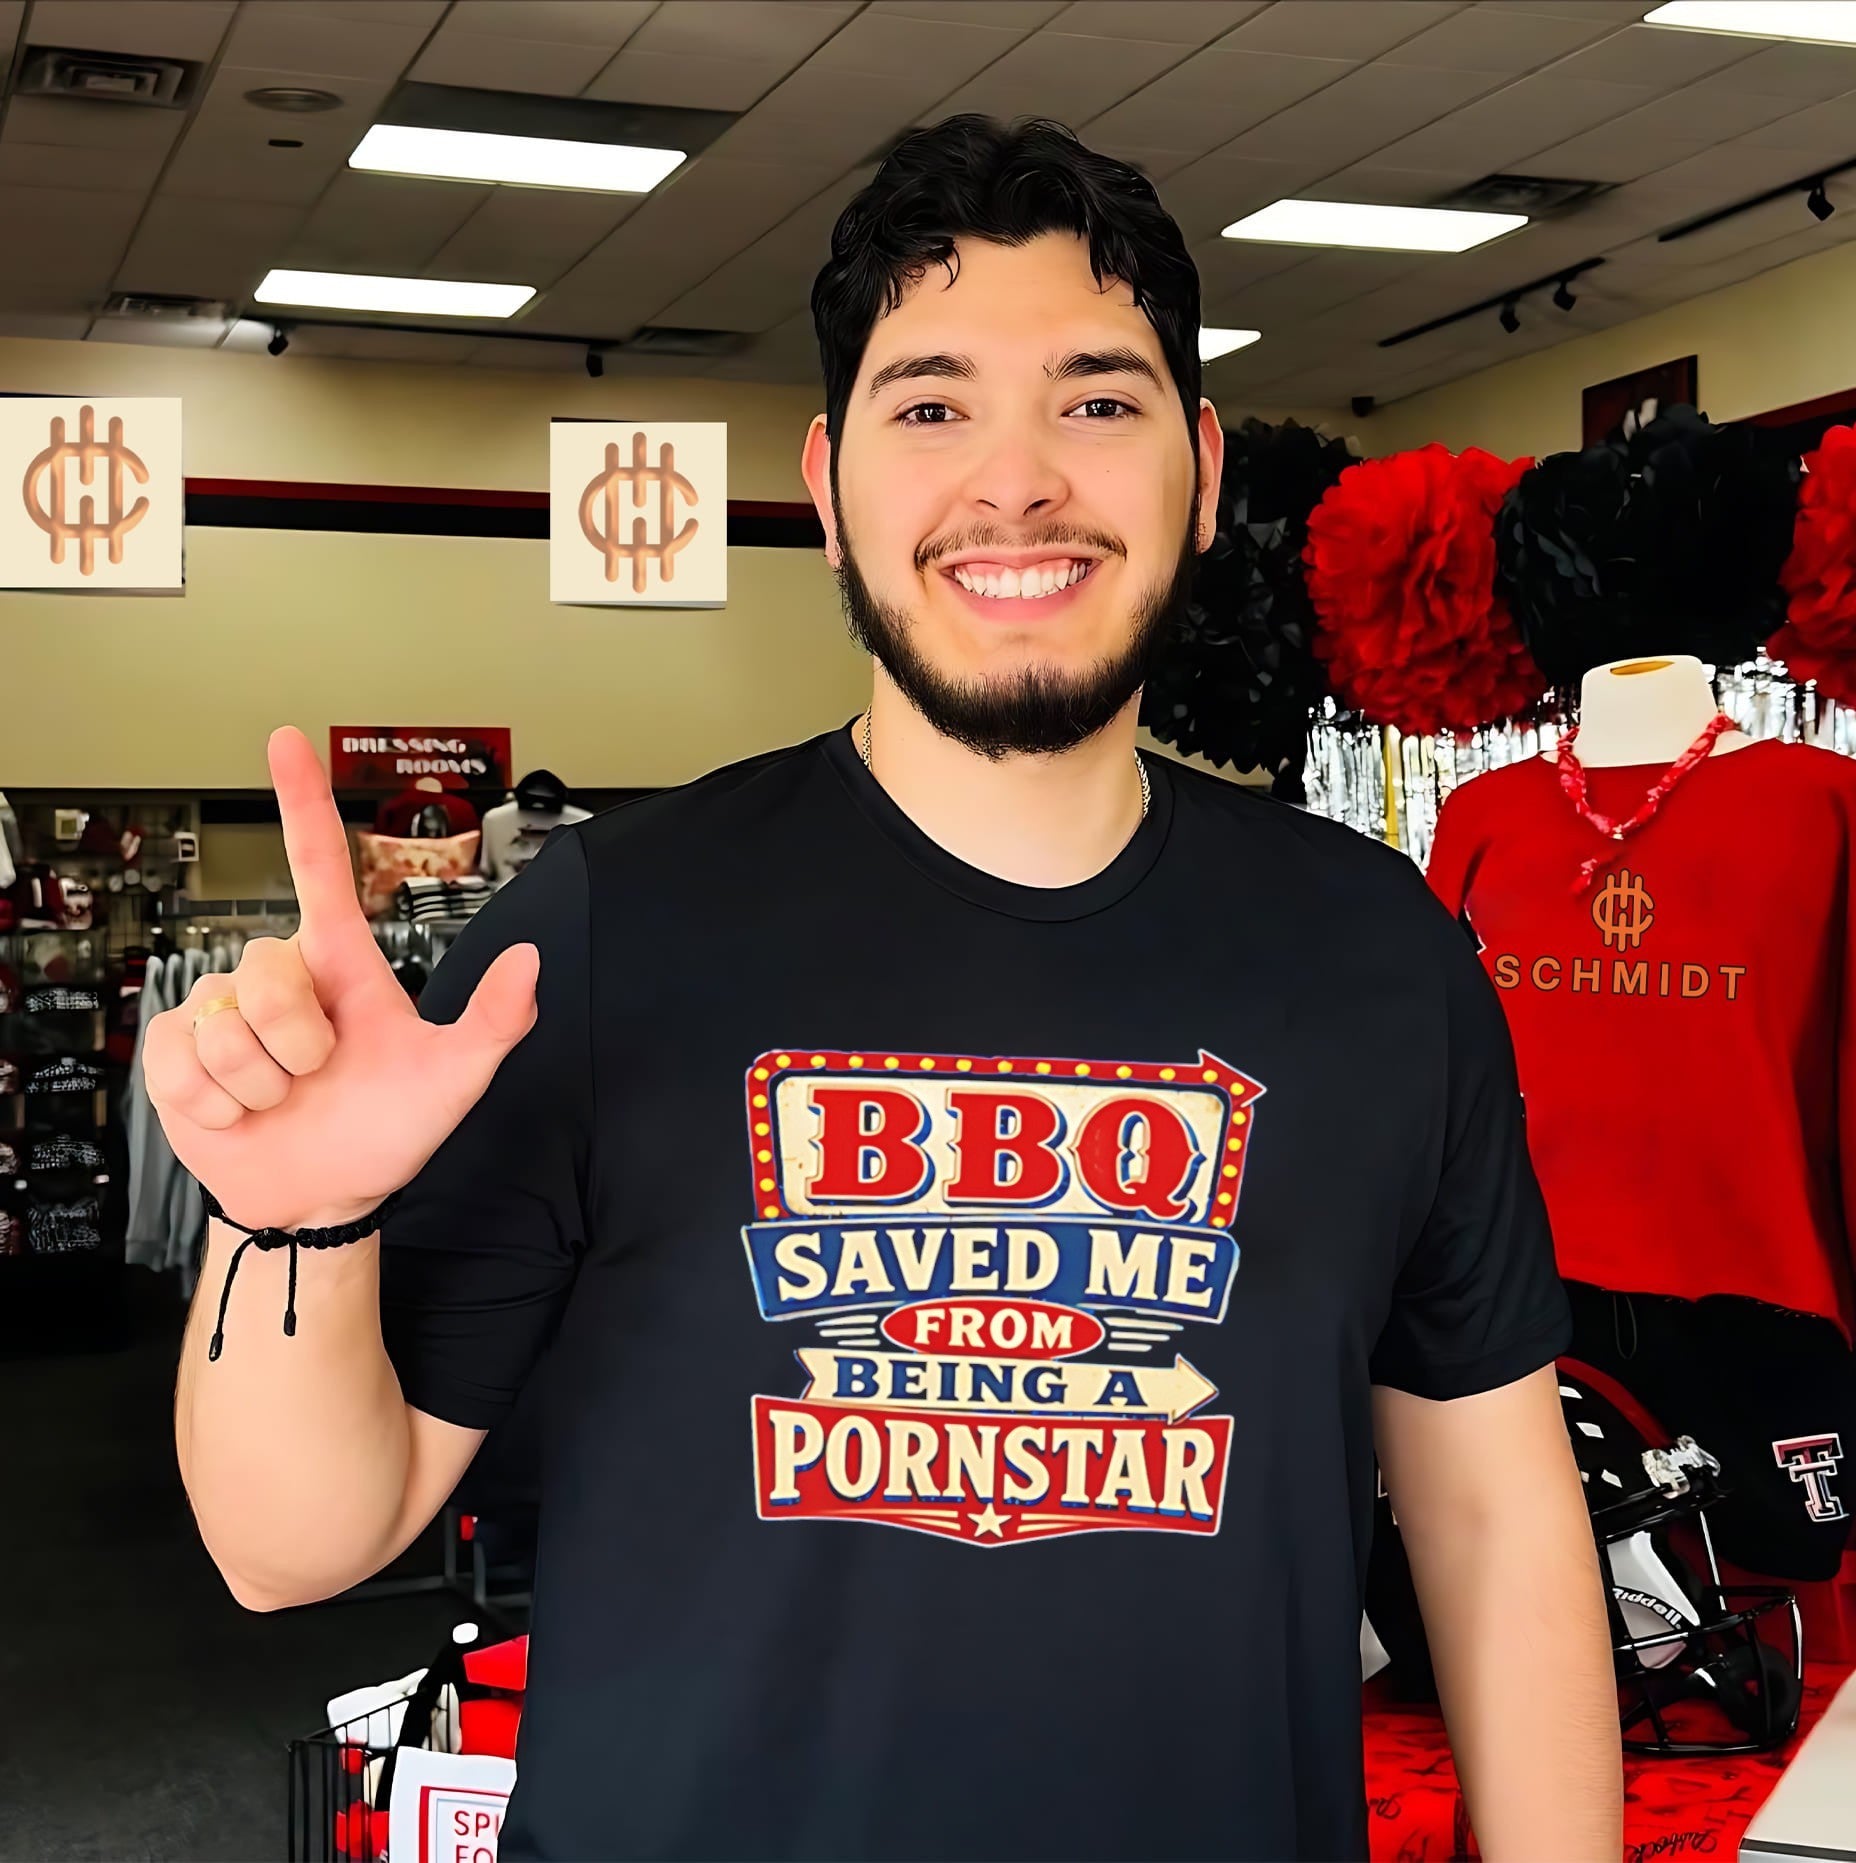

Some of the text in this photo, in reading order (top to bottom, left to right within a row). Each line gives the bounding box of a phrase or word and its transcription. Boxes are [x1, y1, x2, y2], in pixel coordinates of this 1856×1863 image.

[342, 737, 467, 754] DRESSING
[396, 758, 487, 775] ROOMS
[1494, 953, 1747, 1001] SCHMIDT
[806, 1084, 1207, 1222] BBQ
[773, 1229, 1219, 1302] SAVED ME
[913, 1307, 1074, 1350] FROM
[831, 1355, 1148, 1406] BEING A
[768, 1409, 1215, 1520] PORNSTAR
